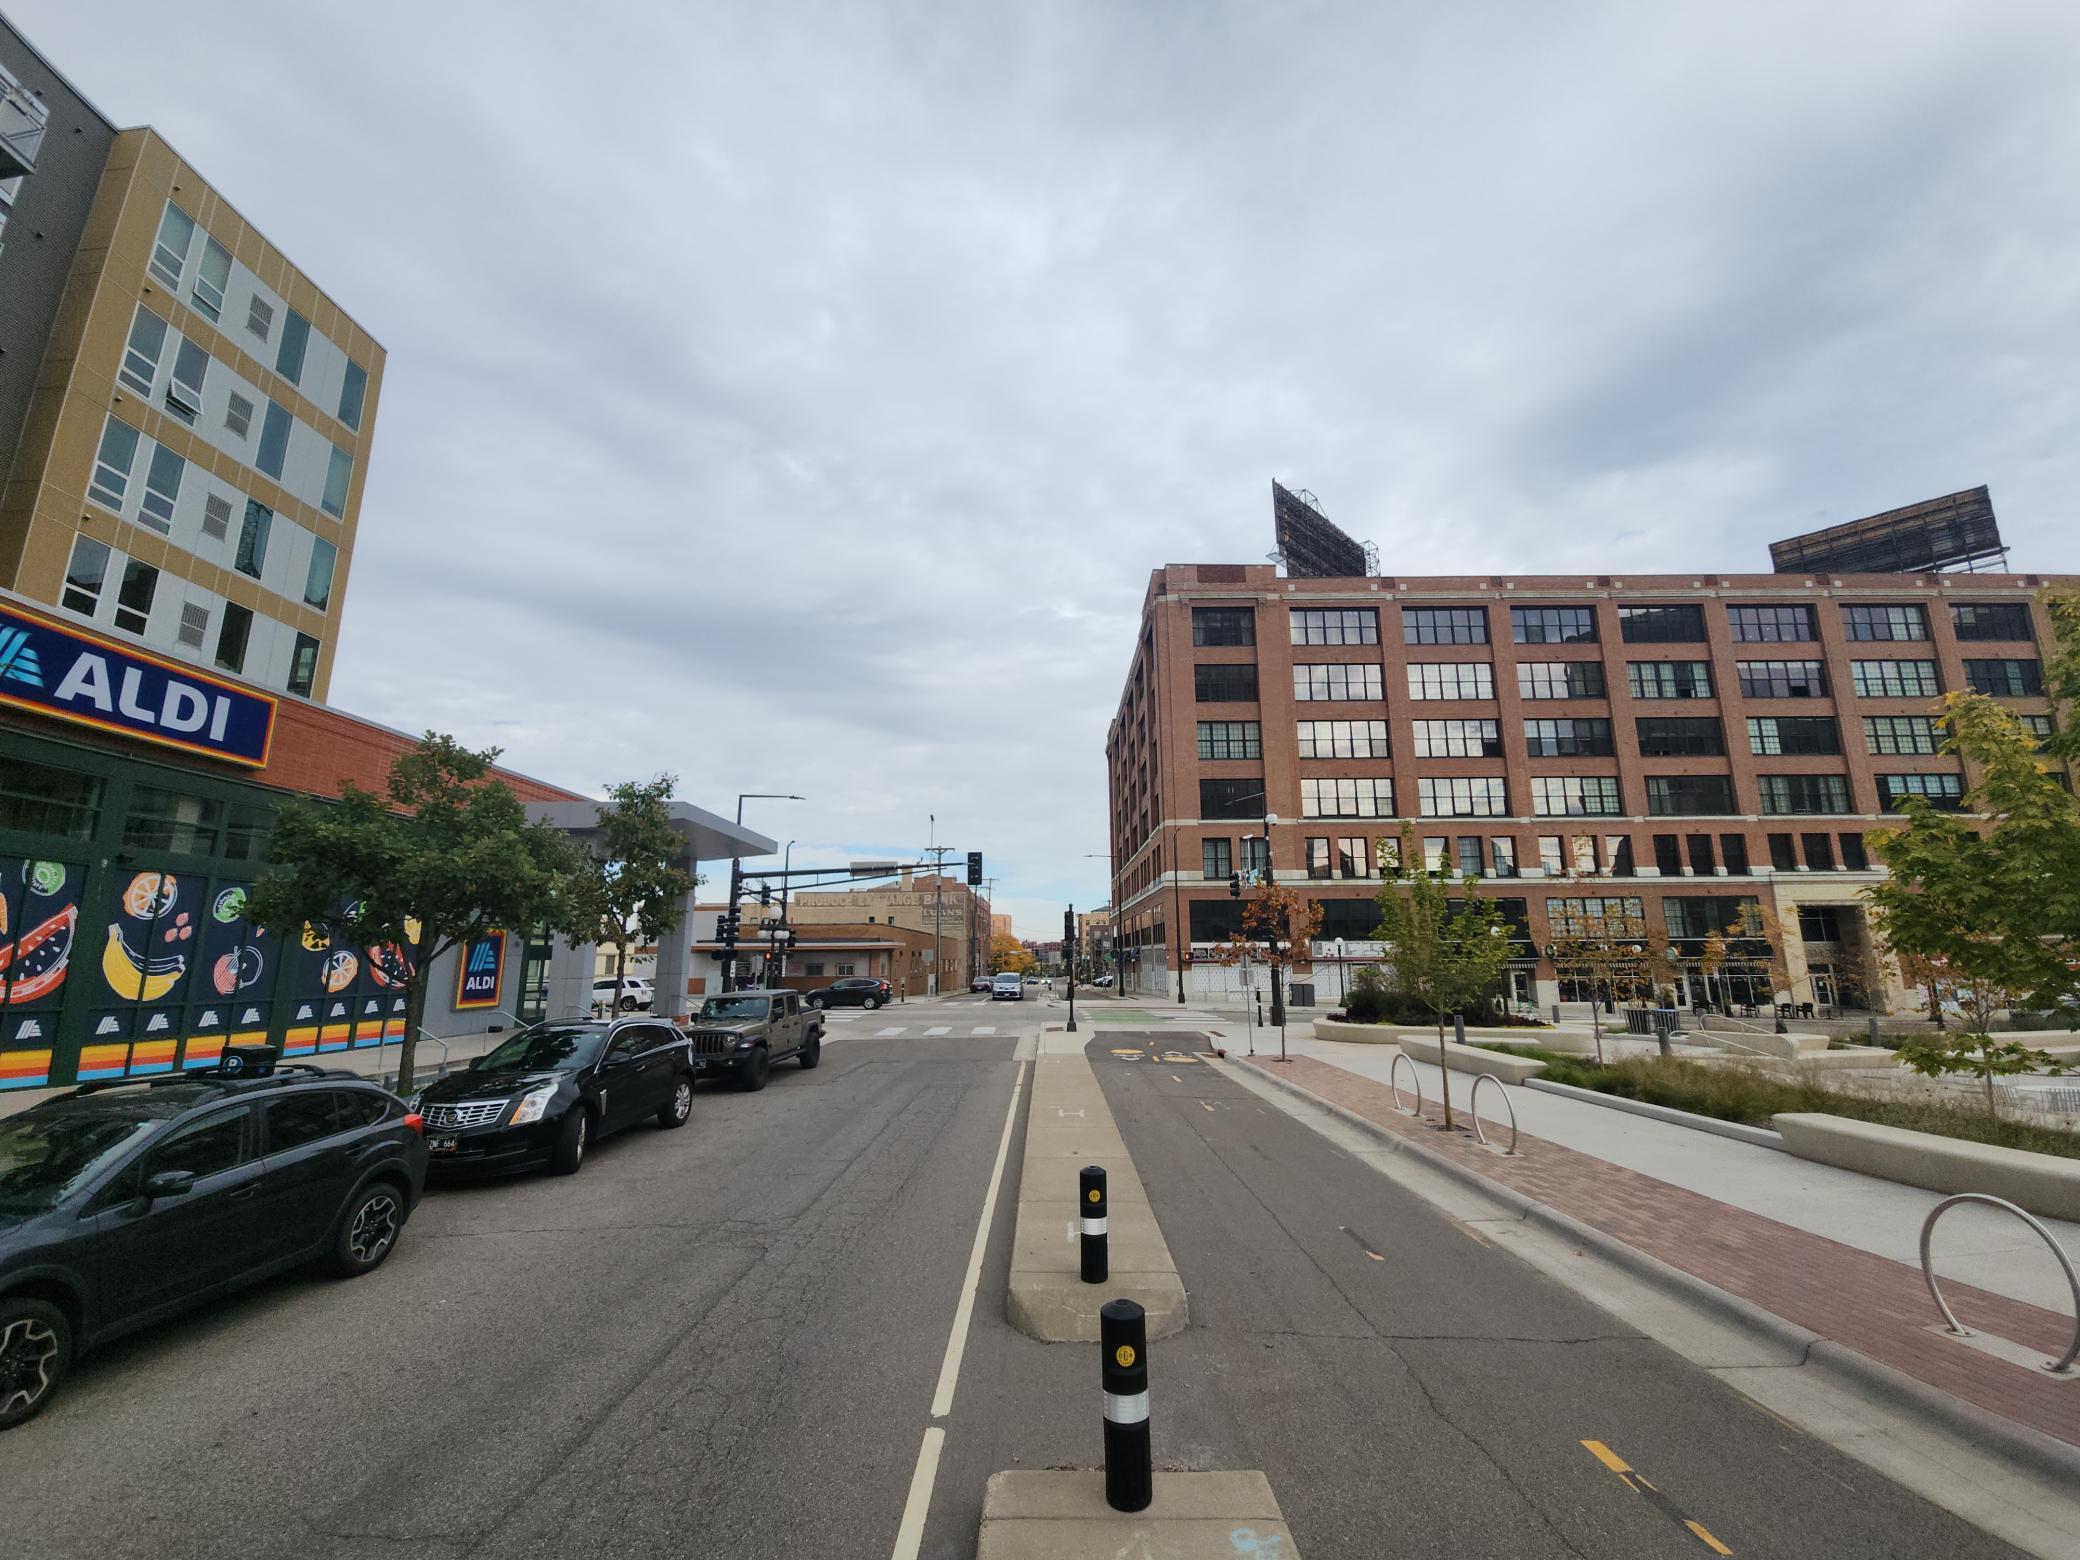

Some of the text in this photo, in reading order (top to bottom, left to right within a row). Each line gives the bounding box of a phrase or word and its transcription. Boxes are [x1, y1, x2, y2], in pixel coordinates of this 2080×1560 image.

[53, 651, 231, 742] ALDI
[857, 893, 920, 906] EXHANGE
[923, 894, 960, 905] BANK
[922, 908, 963, 916] LOANS
[465, 976, 495, 990] ALDI
